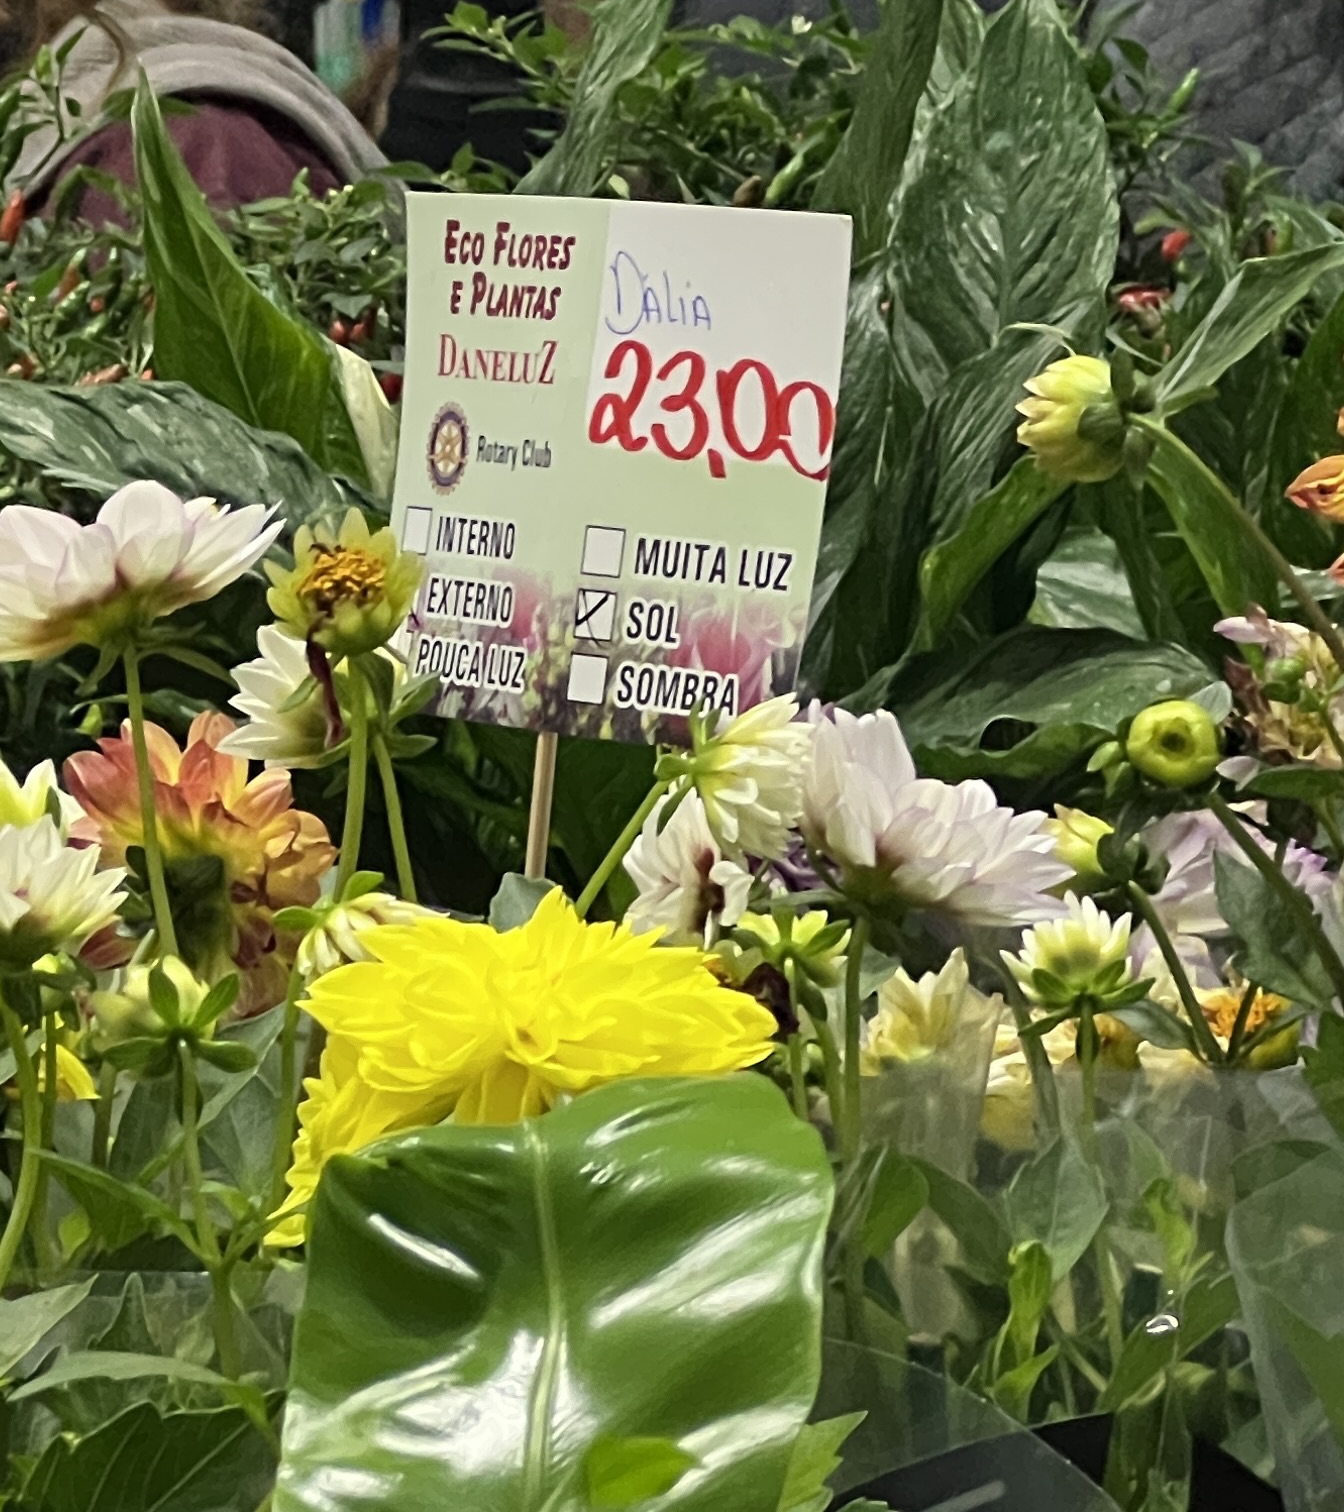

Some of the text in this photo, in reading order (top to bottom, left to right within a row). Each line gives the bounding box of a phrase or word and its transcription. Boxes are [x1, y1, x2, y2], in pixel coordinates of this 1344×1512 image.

[493, 221, 576, 271] FLORES
[470, 271, 562, 320] PLANTAS
[588, 339, 837, 482] 23,00
[476, 435, 552, 470] Rotary Club
[436, 516, 515, 560] INTERNO
[634, 538, 793, 591] MUITA LUZ
[427, 577, 513, 623] EXTERNO
[626, 601, 679, 643] SOL
[415, 639, 525, 688] POUCA LUZ
[617, 665, 734, 716] SOMBRA
